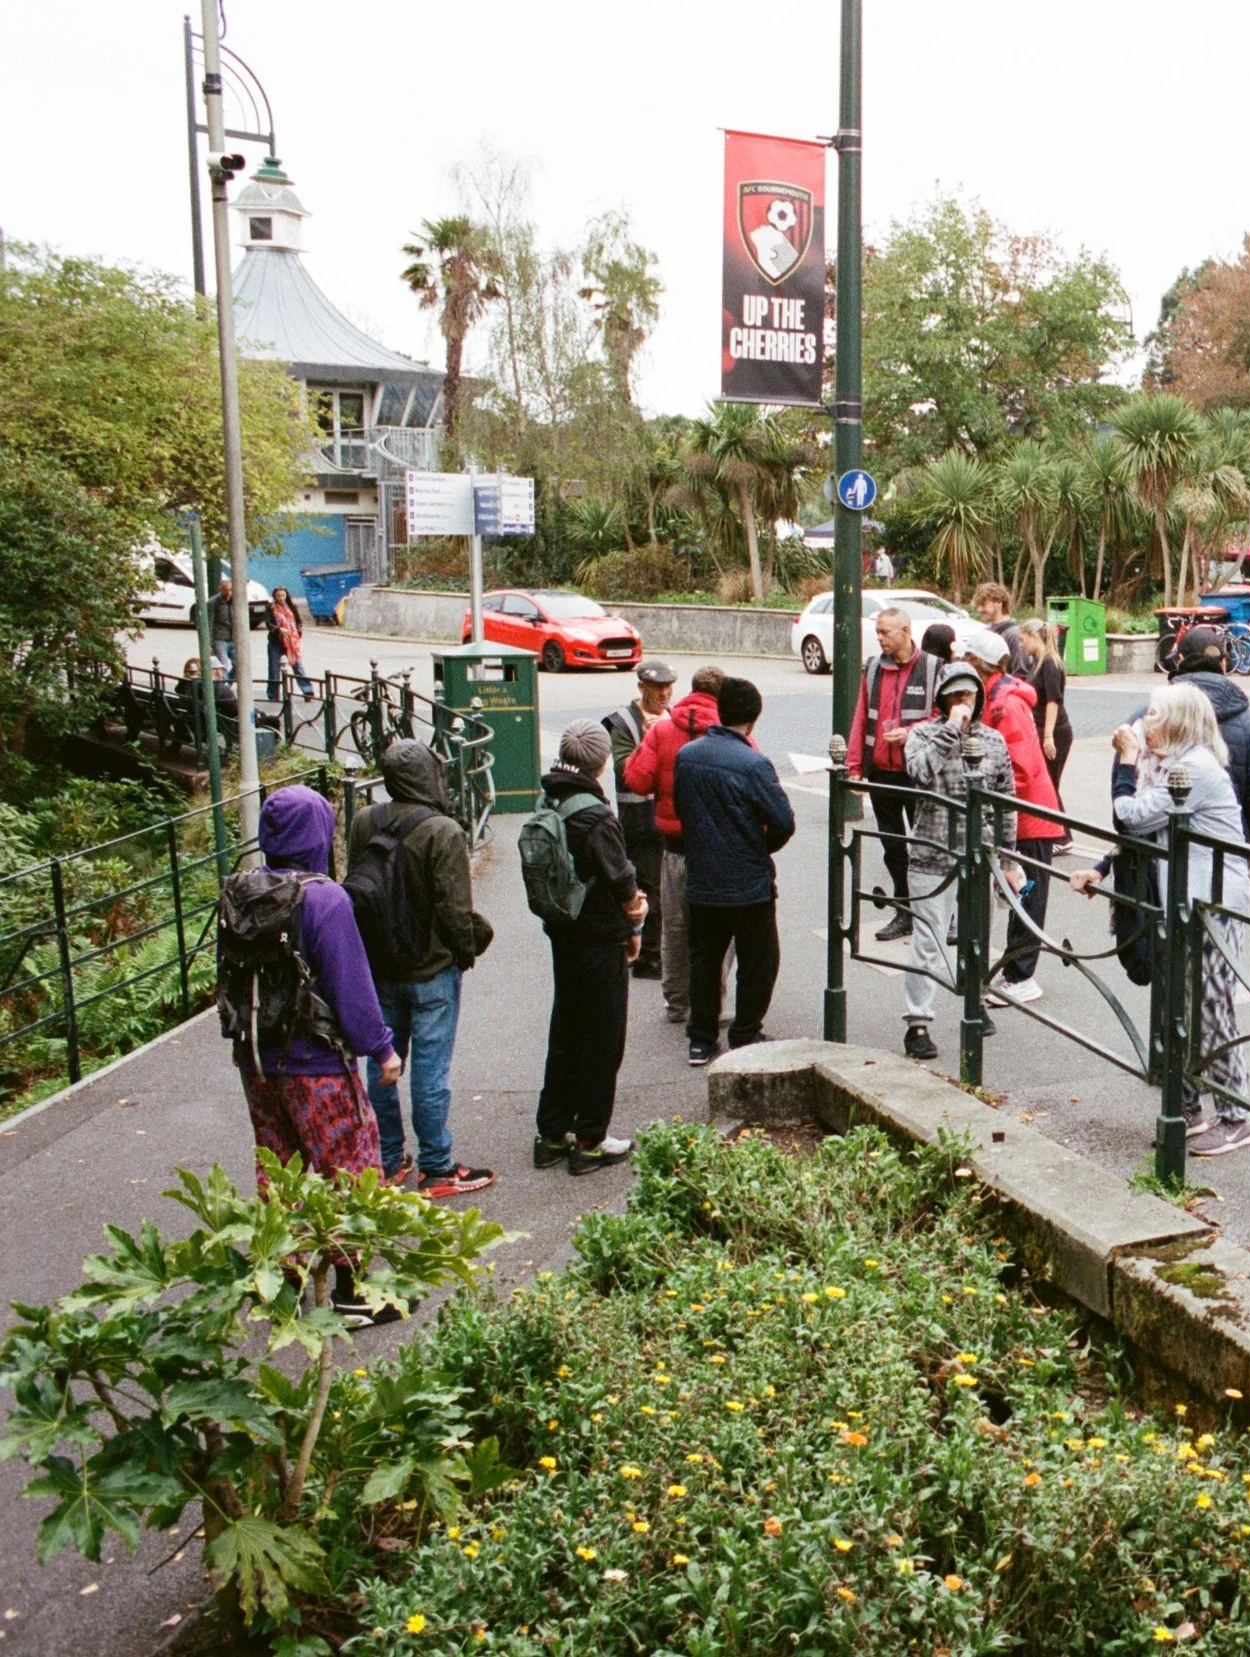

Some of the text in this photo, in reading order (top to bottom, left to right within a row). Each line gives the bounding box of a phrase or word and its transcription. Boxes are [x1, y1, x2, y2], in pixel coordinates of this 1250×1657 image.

[743, 295, 805, 330] UP THE
[729, 327, 817, 365] CHERRIES
